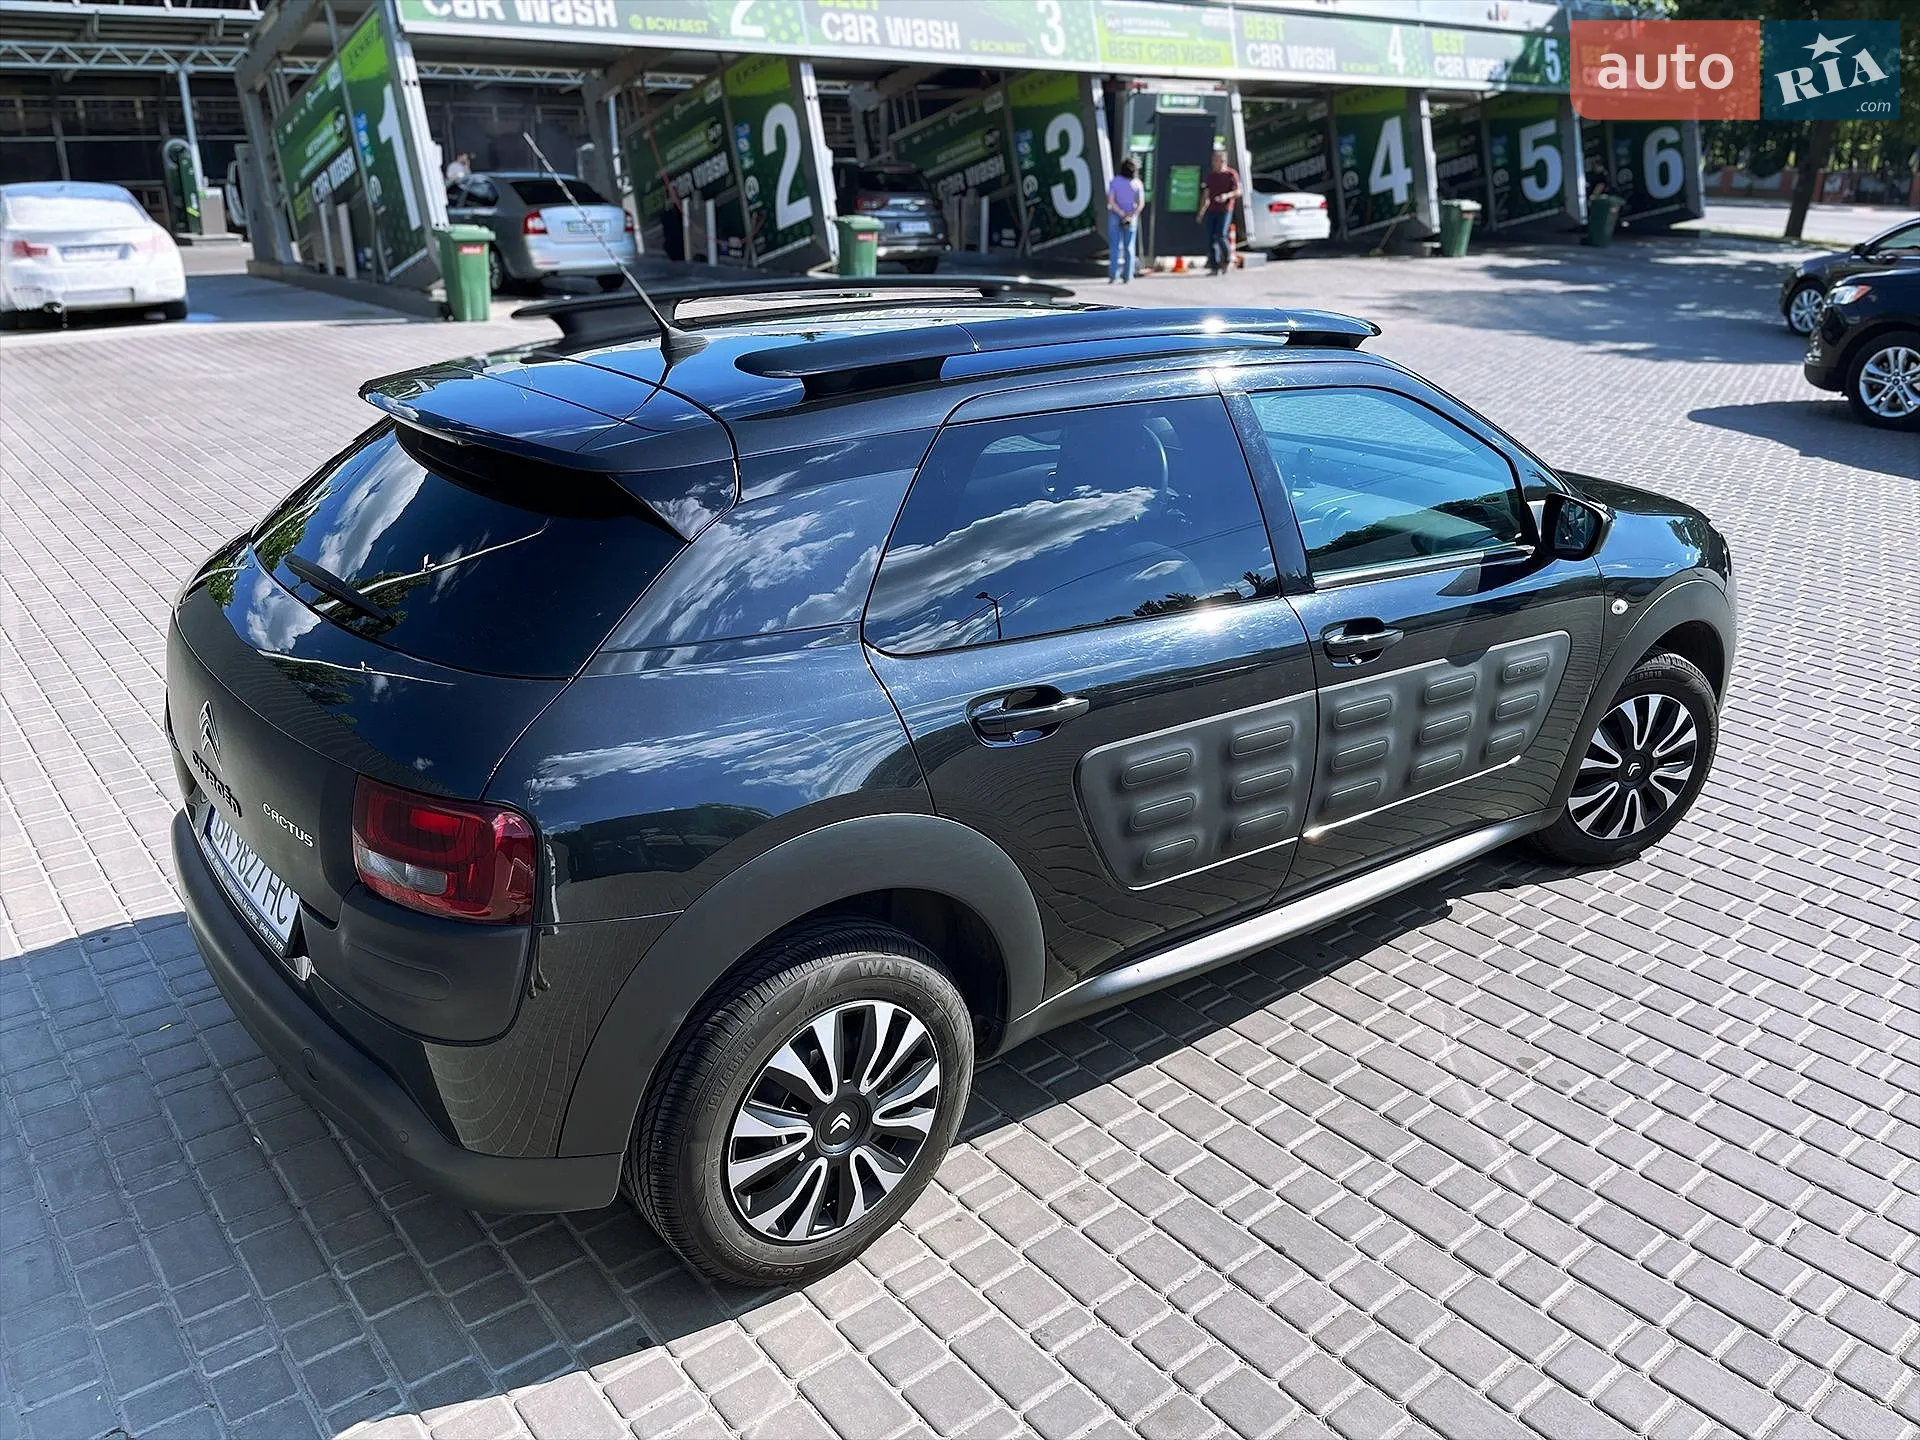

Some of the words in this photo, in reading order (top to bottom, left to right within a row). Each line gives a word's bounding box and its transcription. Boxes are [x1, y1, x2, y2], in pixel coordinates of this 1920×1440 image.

[1036, 0, 1066, 56] 3
[1107, 39, 1144, 60] BEST
[1244, 16, 1286, 41] BEST
[1387, 24, 1407, 75] 4
[1543, 38, 1562, 83] 5
[377, 82, 422, 232] 1
[762, 102, 813, 231] 2
[1044, 112, 1092, 219] 3
[1368, 115, 1413, 205] 4
[1519, 119, 1563, 202] 5
[1643, 126, 1685, 200] 6
[262, 801, 315, 849] CACTUS
